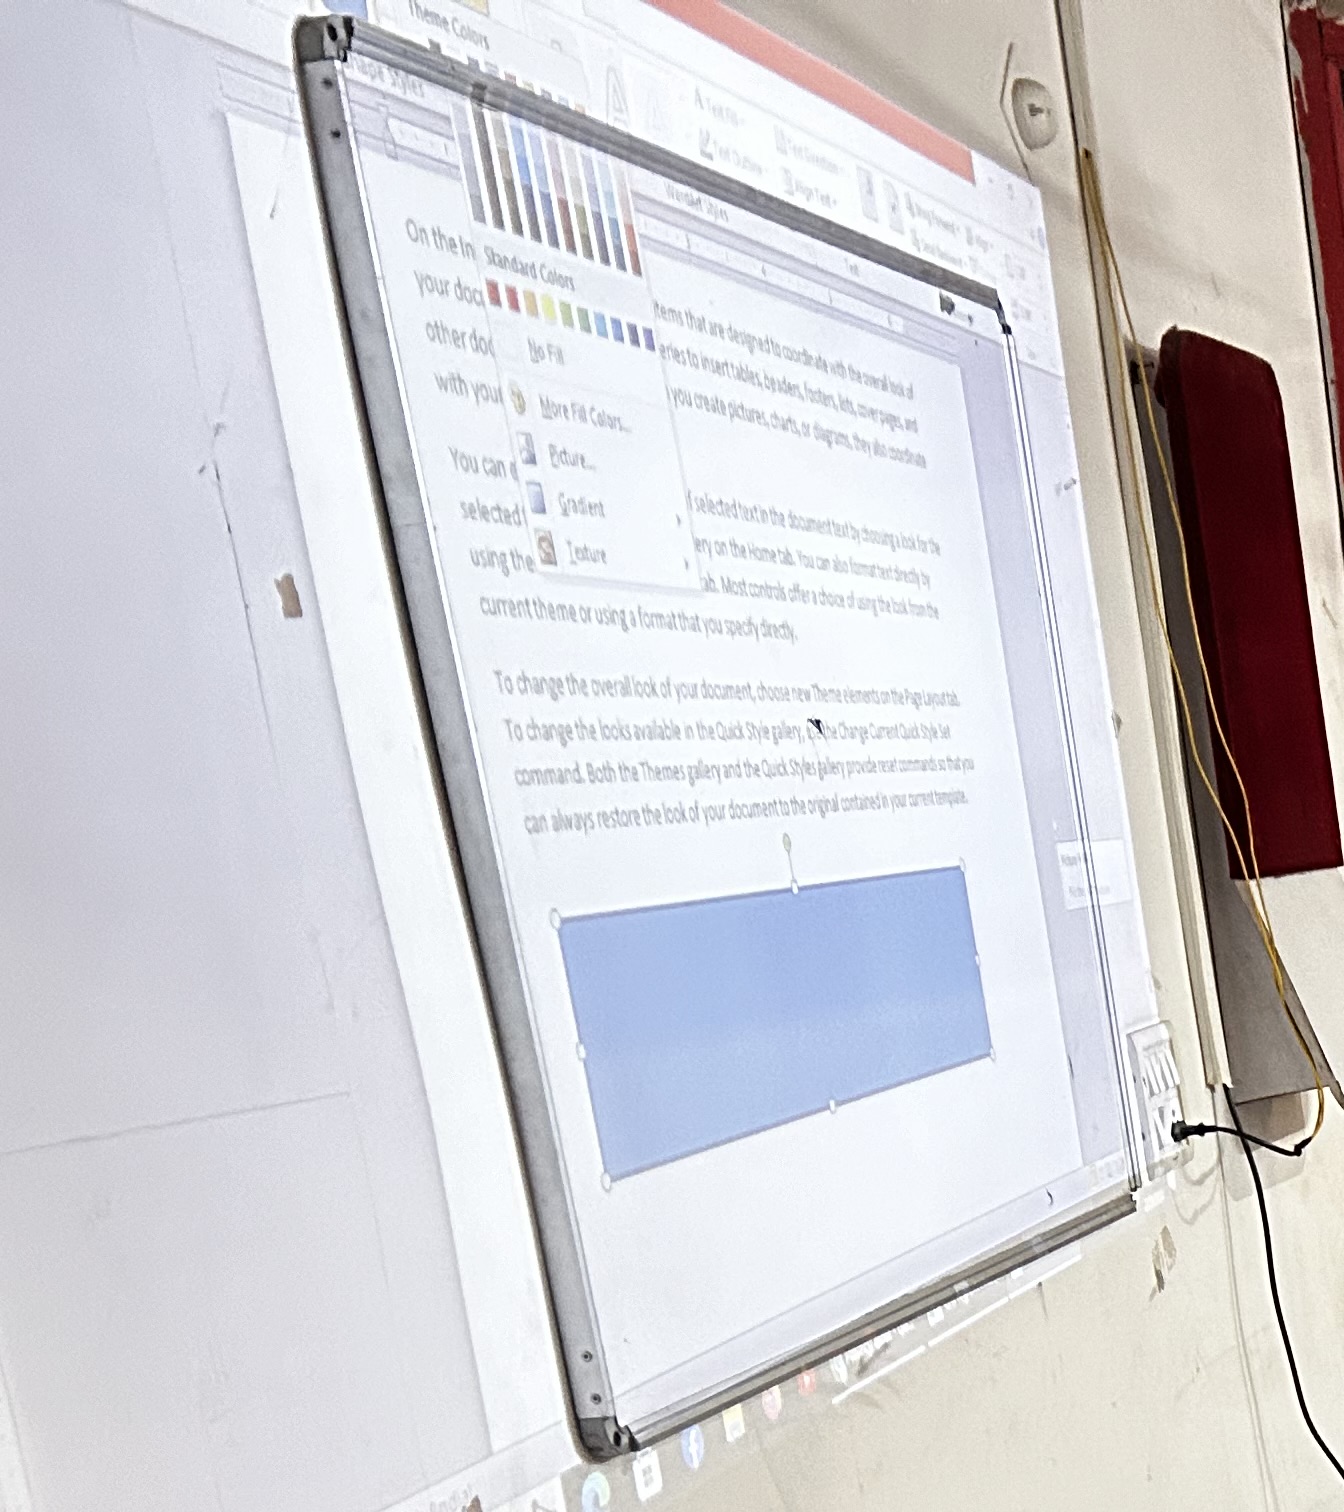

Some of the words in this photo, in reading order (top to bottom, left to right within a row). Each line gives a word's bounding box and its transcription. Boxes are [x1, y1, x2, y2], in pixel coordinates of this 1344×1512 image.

[408, 0, 450, 33] Theme
[451, 17, 489, 50] Colors
[405, 218, 430, 248] On
[431, 225, 459, 255] the
[413, 269, 450, 299] your
[483, 244, 538, 281] Standard
[539, 262, 576, 292] Colors
[425, 319, 466, 351] other
[527, 337, 546, 364] No
[546, 343, 565, 366] Fill
[684, 309, 709, 336] that
[709, 320, 726, 341] are
[726, 321, 771, 356] designed
[770, 337, 782, 358] to
[782, 344, 829, 375] coordinate
[829, 359, 847, 380] with
[847, 363, 862, 385] the
[862, 371, 889, 393] overall
[432, 370, 470, 398] with
[658, 343, 687, 367] eries
[686, 347, 700, 370] to
[700, 353, 731, 379] insert
[857, 403, 879, 422] cover
[904, 417, 919, 434] and
[538, 394, 569, 421] More
[570, 402, 588, 423] Fill
[670, 387, 693, 410] you
[693, 391, 727, 417] create
[727, 399, 770, 430] pictures,
[769, 410, 802, 437] charts,
[812, 421, 853, 450] diagrams,
[852, 432, 872, 459] they
[871, 438, 888, 459] also
[447, 445, 480, 475] You
[481, 456, 507, 479] can
[459, 496, 522, 528] selected
[558, 491, 606, 519] Gradient
[694, 492, 739, 520] selected
[738, 500, 761, 525] text
[768, 506, 786, 529] the
[786, 509, 832, 536] document
[831, 519, 850, 541] text
[849, 522, 861, 546] by
[860, 525, 896, 553] choosing
[899, 532, 917, 552] look
[469, 547, 510, 578] using
[509, 547, 536, 574] the
[564, 538, 608, 565] Texture
[713, 540, 728, 558] on
[728, 537, 747, 560] the
[747, 541, 778, 565] Home
[795, 549, 815, 570] You
[814, 555, 831, 572] can
[830, 554, 849, 574] also
[848, 556, 877, 579] format
[876, 562, 895, 581] text
[894, 565, 921, 590] directly
[719, 575, 749, 597] Most
[748, 580, 788, 602] controls
[787, 582, 812, 605] offer
[817, 585, 846, 609] choice
[856, 597, 879, 618] using
[876, 595, 892, 615] the
[890, 596, 909, 616] look
[908, 597, 927, 618] from
[479, 596, 533, 621] current
[532, 596, 578, 623] theme
[579, 605, 593, 625] or
[593, 603, 630, 633] using
[629, 609, 637, 628] a
[636, 604, 679, 631] format
[677, 608, 702, 633] that
[701, 616, 723, 641] you
[723, 615, 760, 643] specify
[759, 616, 799, 645] directly.
[493, 669, 514, 696] To
[515, 669, 565, 702] change
[564, 671, 590, 699] the
[590, 675, 632, 699] overall
[631, 675, 660, 699] look
[659, 676, 672, 700] of
[672, 682, 699, 704] your
[699, 676, 757, 704] document,
[756, 680, 790, 703] choose
[790, 687, 811, 703] new
[810, 682, 843, 704] Theme
[842, 685, 881, 705] elements
[889, 688, 905, 706] the
[904, 688, 922, 711] Page
[502, 717, 524, 743] To
[525, 715, 574, 749] change
[573, 716, 598, 742] the
[597, 716, 633, 742] looks
[632, 719, 682, 742] available
[682, 720, 695, 741] in
[694, 718, 715, 742] the
[714, 719, 746, 743] Quick
[745, 719, 770, 746] Style
[770, 719, 806, 746] gallery,
[838, 720, 869, 746] Change
[868, 721, 900, 742] Current
[899, 722, 921, 742] Quick
[920, 722, 939, 744] Style
[938, 722, 952, 741] Set
[514, 760, 586, 787] command.
[585, 760, 617, 785] Both
[616, 760, 640, 783] the
[638, 760, 687, 785] Themes
[685, 757, 722, 788] gallery
[721, 757, 743, 780] and
[742, 757, 761, 780] the
[760, 757, 790, 780] Quick
[789, 756, 818, 783] Styles
[816, 756, 846, 781] gallery
[845, 755, 878, 779] provide
[877, 758, 898, 773] reset
[897, 756, 938, 773] commands
[523, 813, 548, 835] can
[550, 807, 595, 836] always
[595, 805, 642, 831] restore
[640, 802, 662, 827] the
[660, 801, 689, 825] look
[687, 799, 701, 824] of
[700, 804, 727, 828] your
[727, 798, 779, 821] document
[777, 798, 791, 818] to
[789, 796, 808, 816] the
[807, 793, 841, 819] original
[840, 792, 881, 812] contained
[889, 795, 909, 813] your
[907, 790, 935, 808] current
